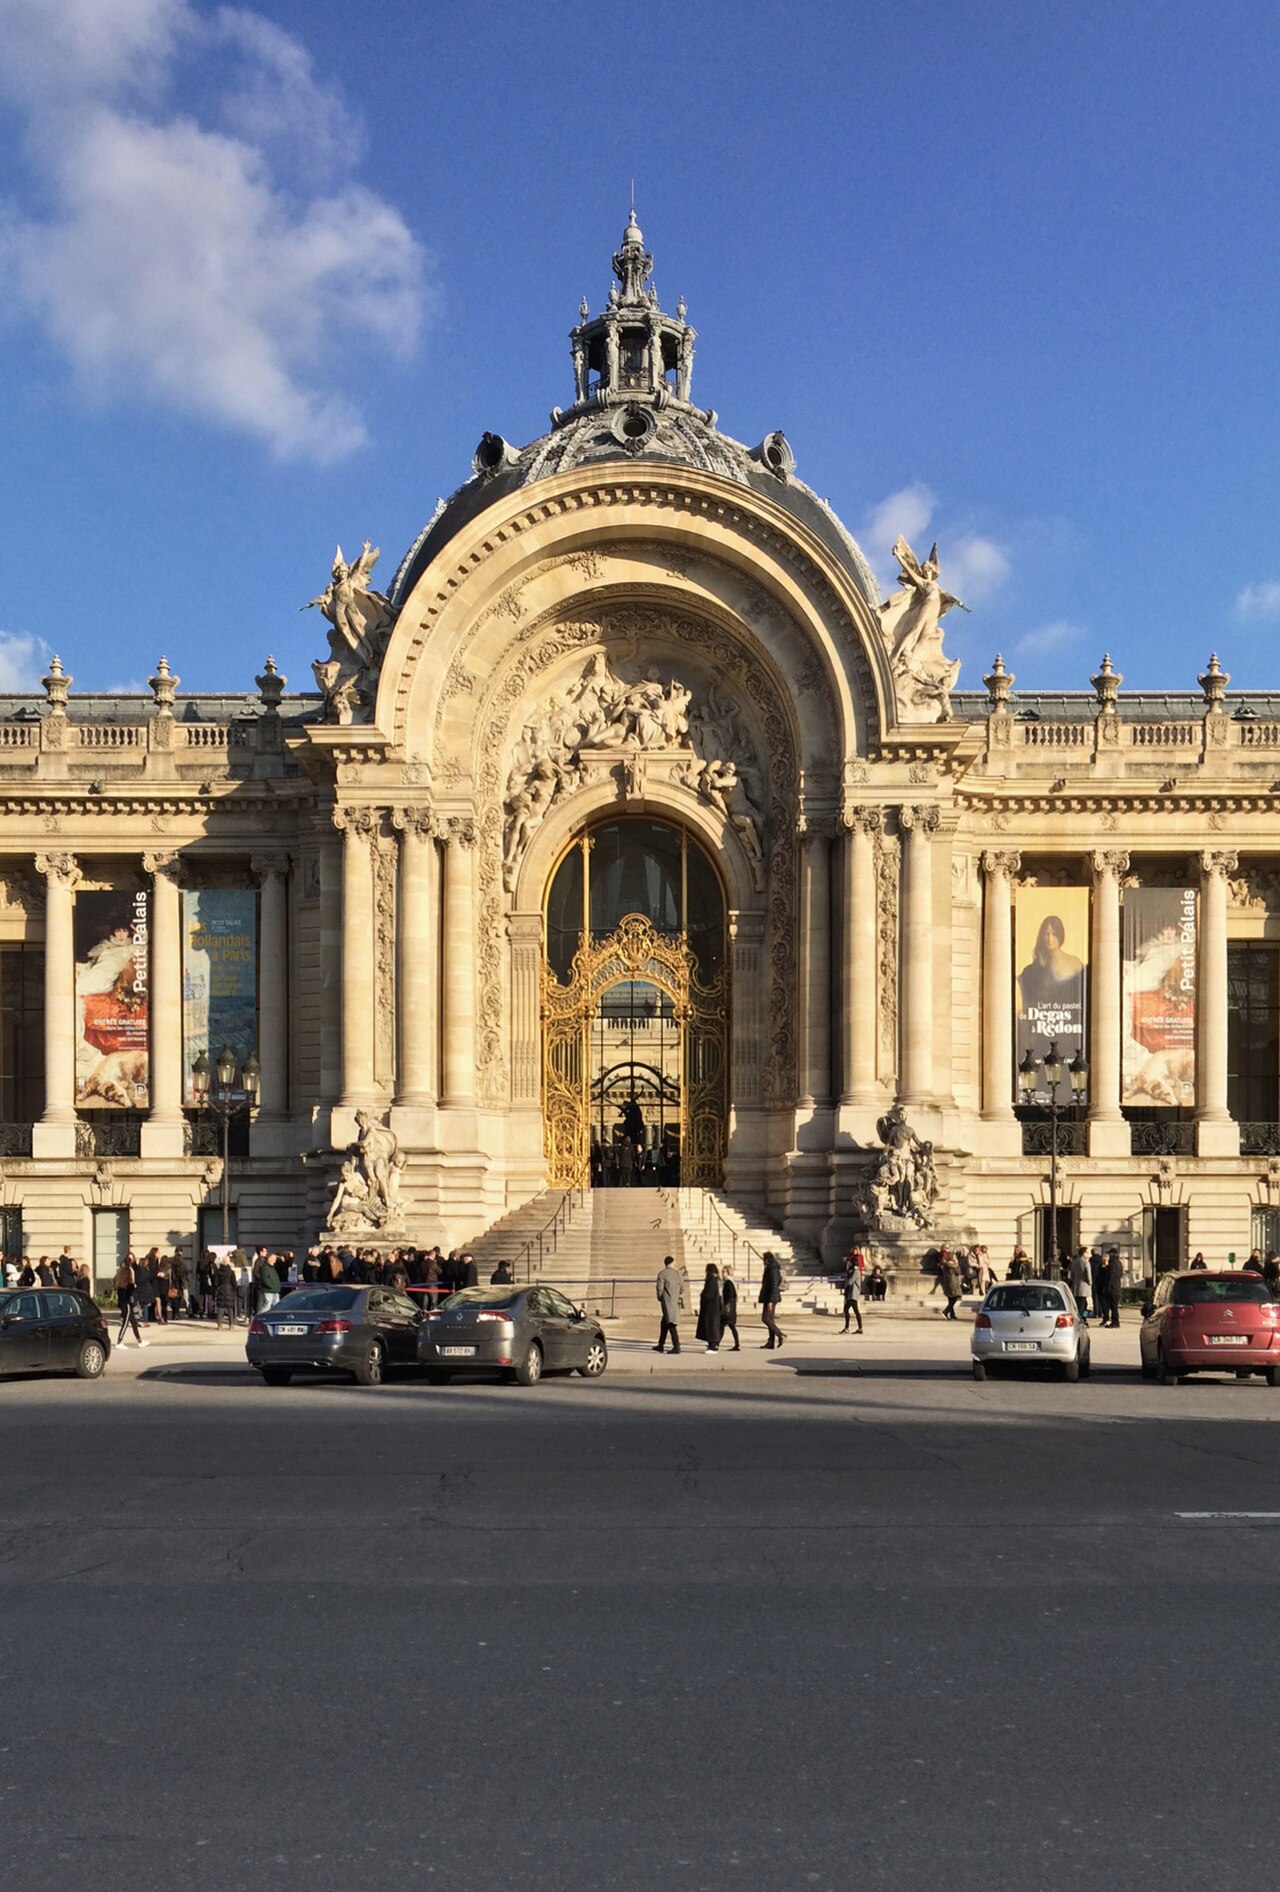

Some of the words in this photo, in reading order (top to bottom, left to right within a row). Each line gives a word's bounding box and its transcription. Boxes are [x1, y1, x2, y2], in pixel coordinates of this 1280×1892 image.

[132, 891, 147, 944] Palais
[1180, 889, 1195, 943] Palais
[188, 919, 207, 932] Les
[188, 934, 250, 948] Hollandais
[223, 949, 250, 961] Paris
[133, 950, 148, 992] Petit
[1180, 947, 1195, 991] Petit
[1052, 1001, 1061, 1010] du
[1062, 1001, 1082, 1011] pastel
[1019, 1012, 1027, 1020] de
[1027, 1007, 1072, 1024] Degas
[1036, 1020, 1082, 1037] Redon
